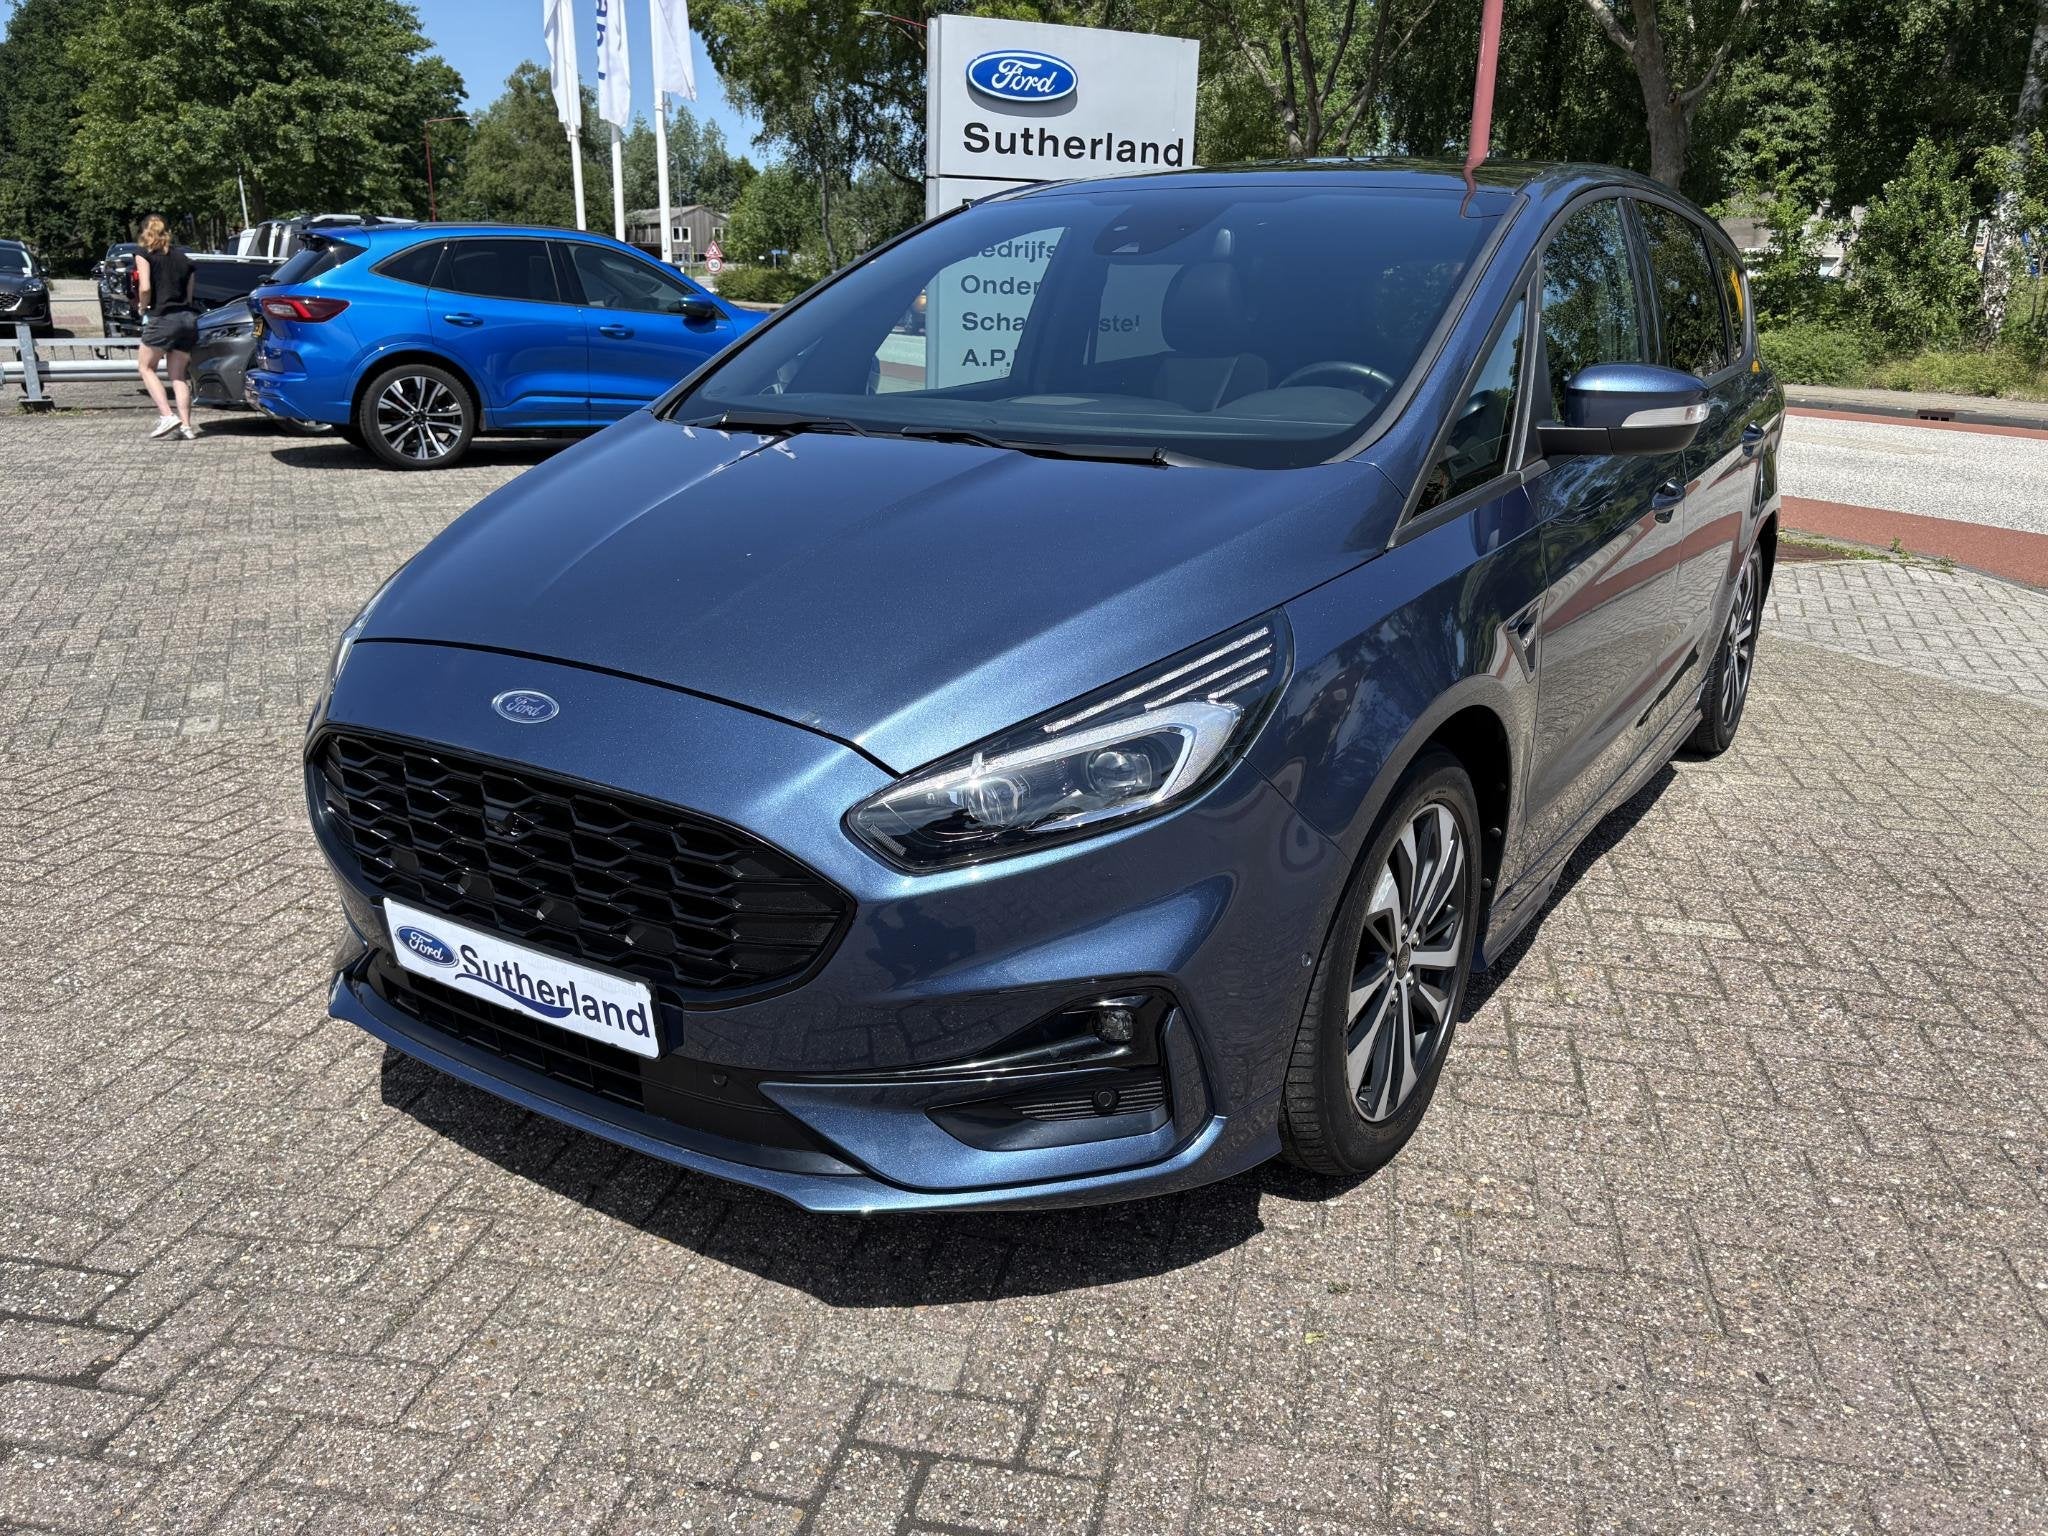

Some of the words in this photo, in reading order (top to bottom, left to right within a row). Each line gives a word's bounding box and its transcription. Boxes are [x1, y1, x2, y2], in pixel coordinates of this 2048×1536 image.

[991, 59, 1057, 93] Ford
[963, 122, 1184, 167] Sutherland
[980, 240, 1056, 263] edrijfs
[961, 348, 1016, 368] A.P.
[506, 695, 546, 717] Ford
[408, 931, 445, 962] Ford
[461, 944, 651, 1038] Sutherland
